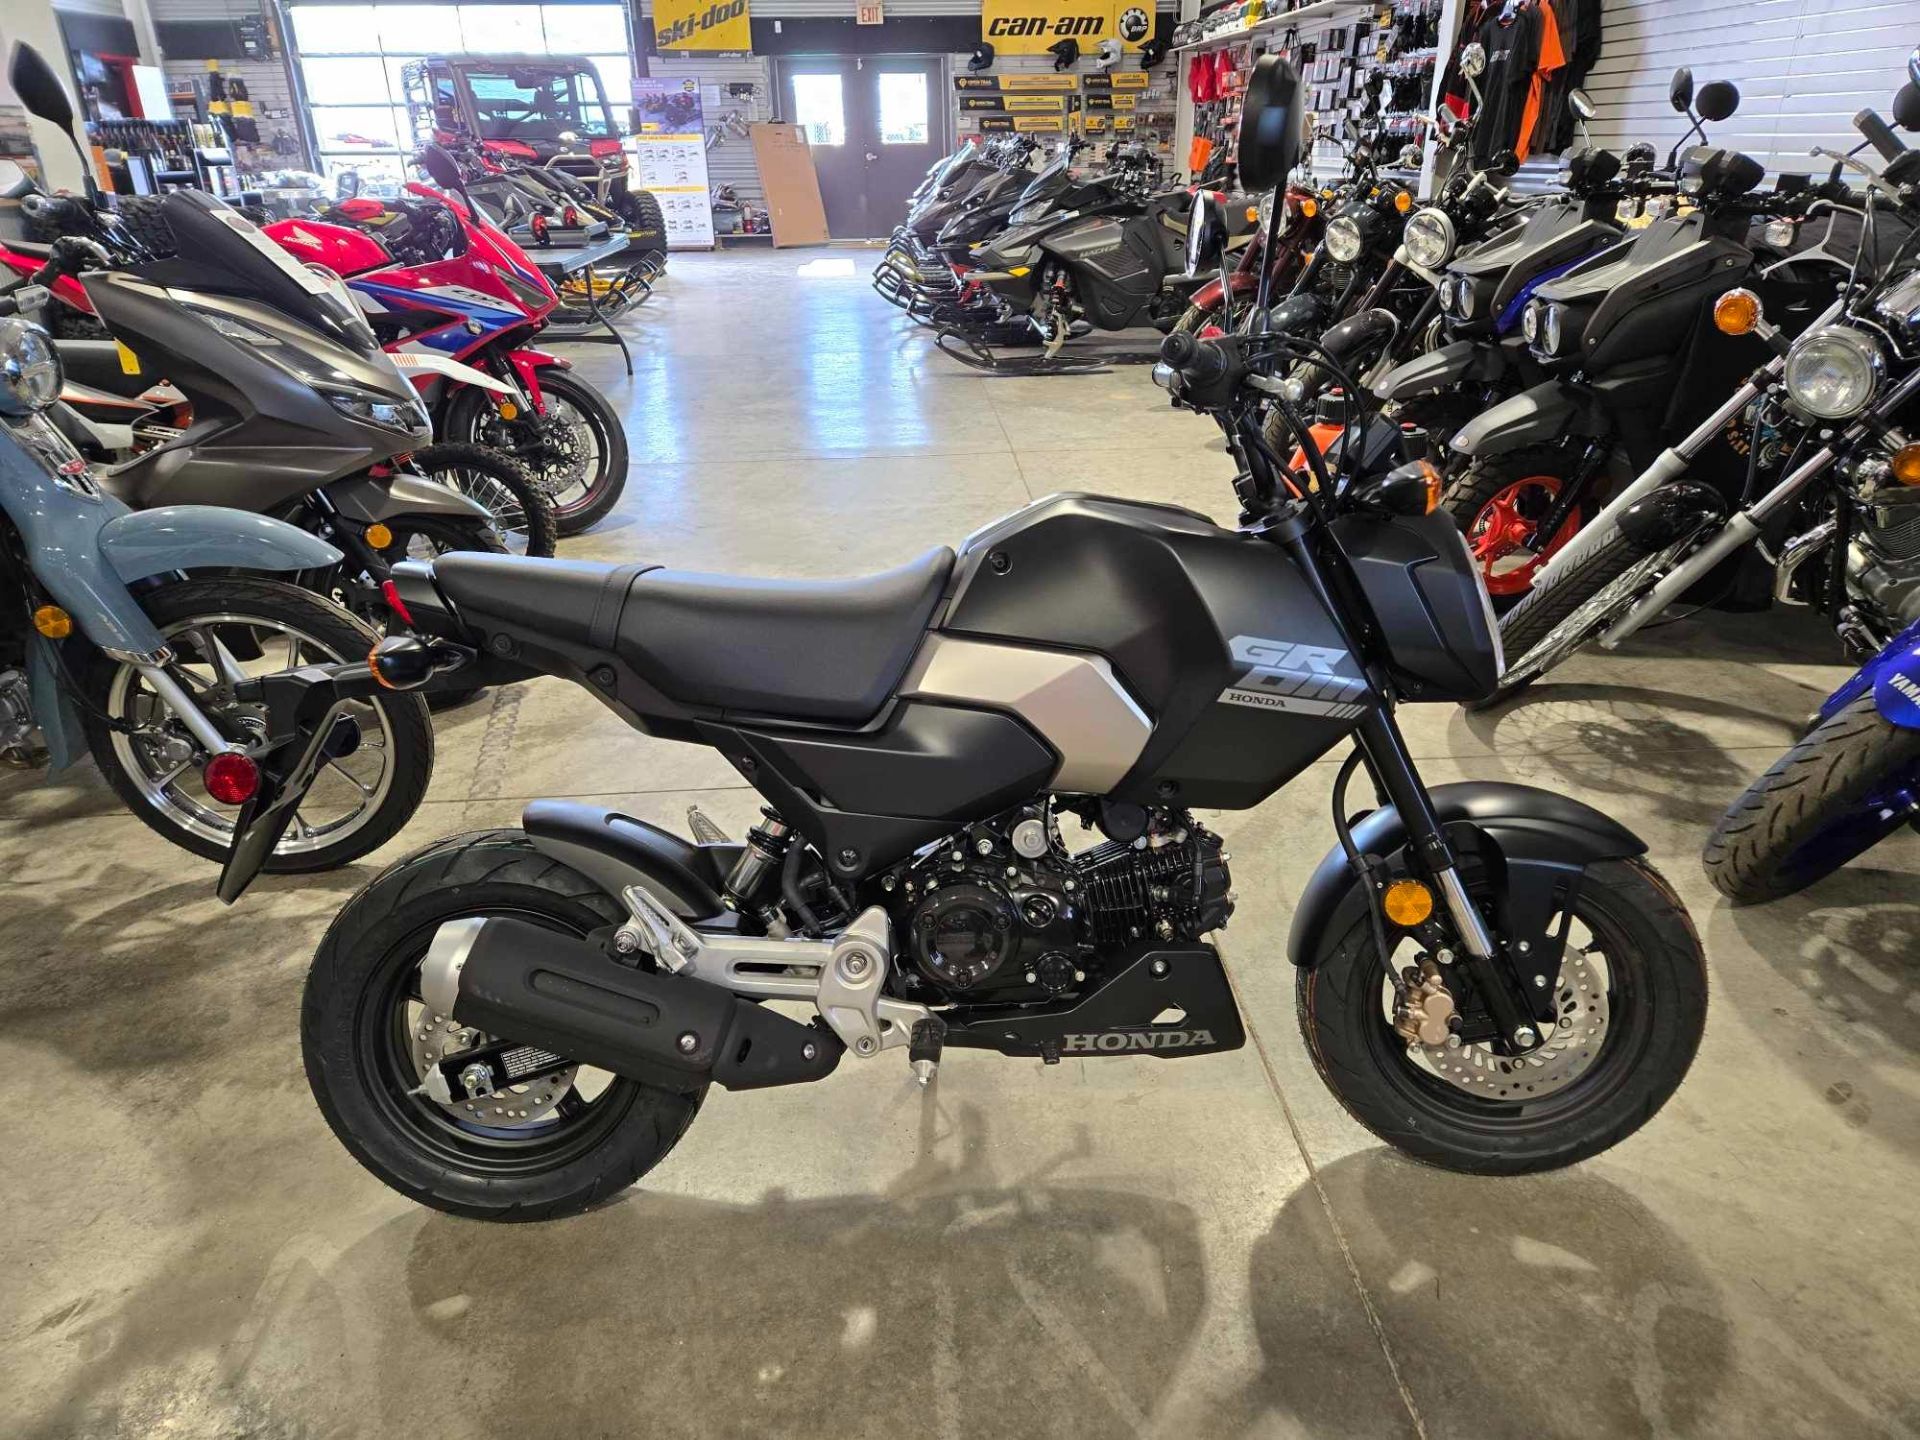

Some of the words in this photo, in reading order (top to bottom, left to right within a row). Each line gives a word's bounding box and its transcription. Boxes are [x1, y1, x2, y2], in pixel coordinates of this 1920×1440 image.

[657, 0, 746, 48] ski-doo
[861, 7, 879, 23] EXIT
[988, 17, 1104, 37] can-am
[1229, 693, 1286, 708] HONDA
[1063, 1030, 1217, 1051] HONDA
